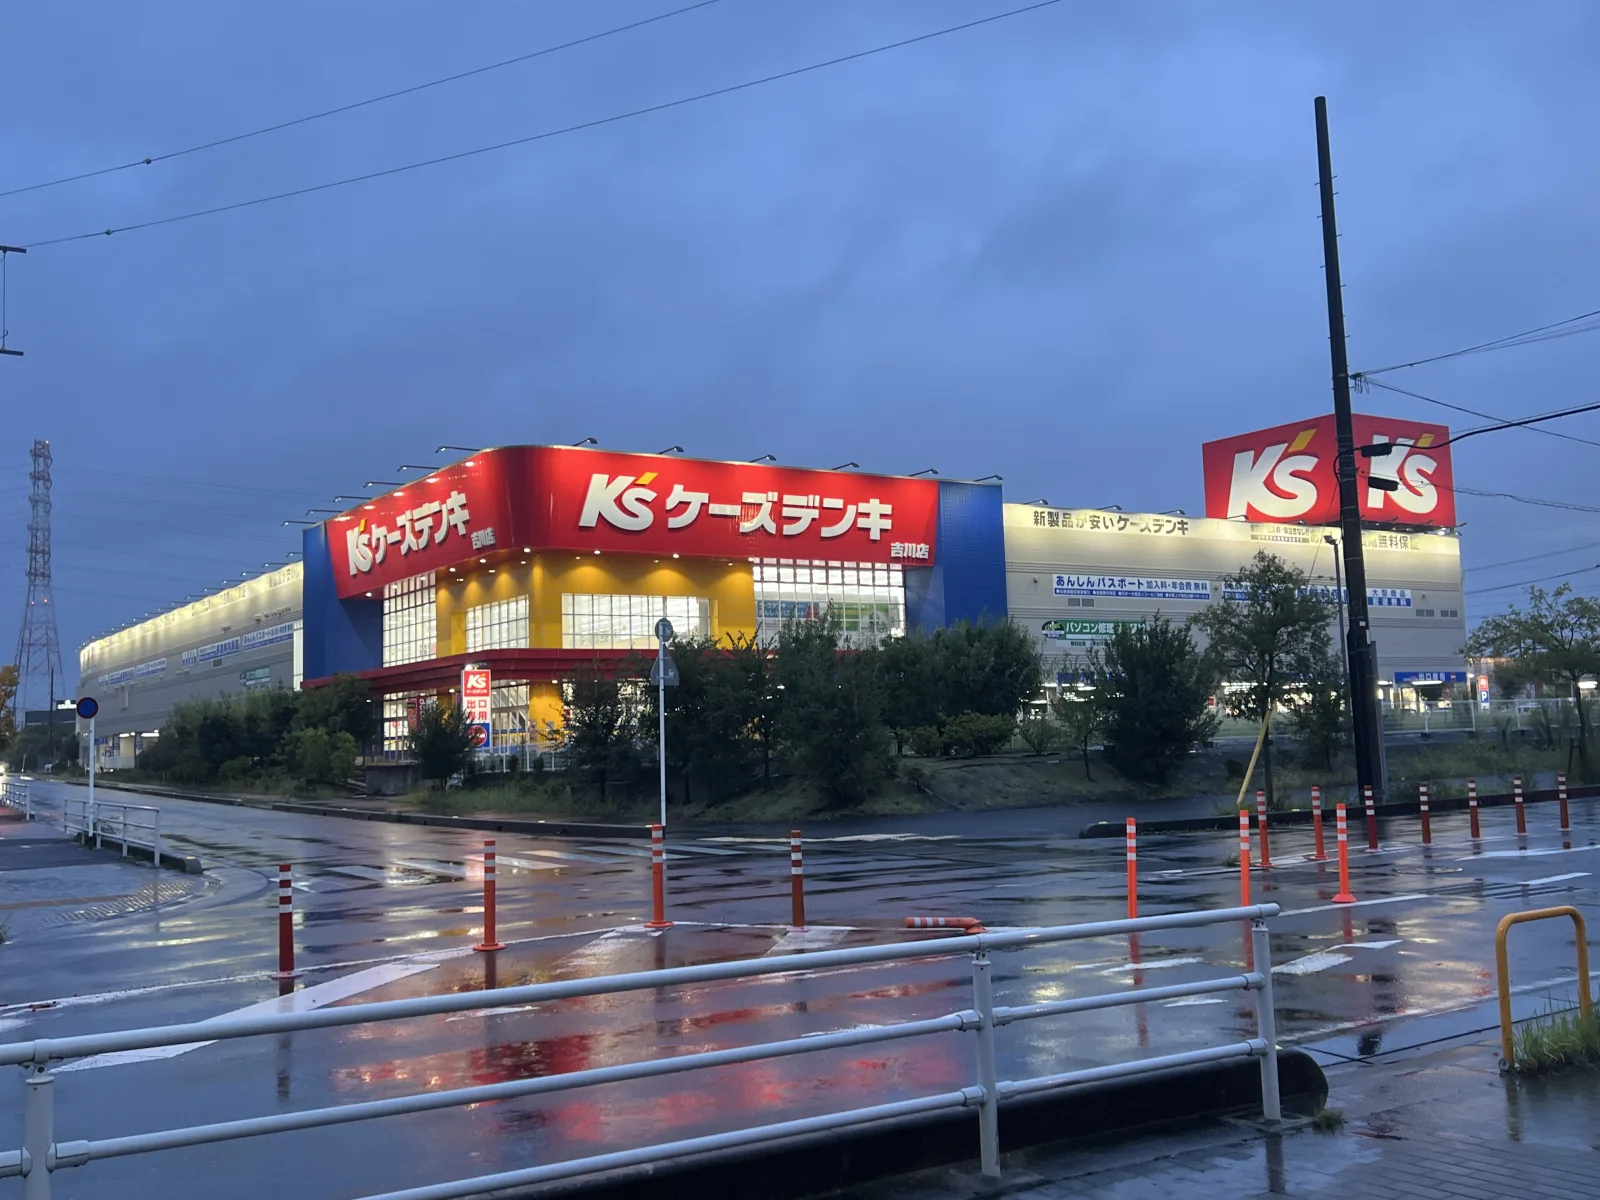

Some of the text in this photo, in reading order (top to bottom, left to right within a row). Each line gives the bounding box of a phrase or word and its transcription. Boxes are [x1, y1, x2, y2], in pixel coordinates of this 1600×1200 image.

[1227, 429, 1319, 521] K's
[1367, 433, 1438, 514] K's
[578, 472, 892, 540] K's ケーズデンキ
[346, 491, 470, 575] K's ケーズデンキ
[1033, 510, 1188, 535] 新製品が安いケーズデンキ
[891, 542, 929, 558] 吉川店
[1056, 575, 1144, 589] あんしんパスポート
[466, 673, 487, 689] K's
[467, 700, 487, 709] 出口
